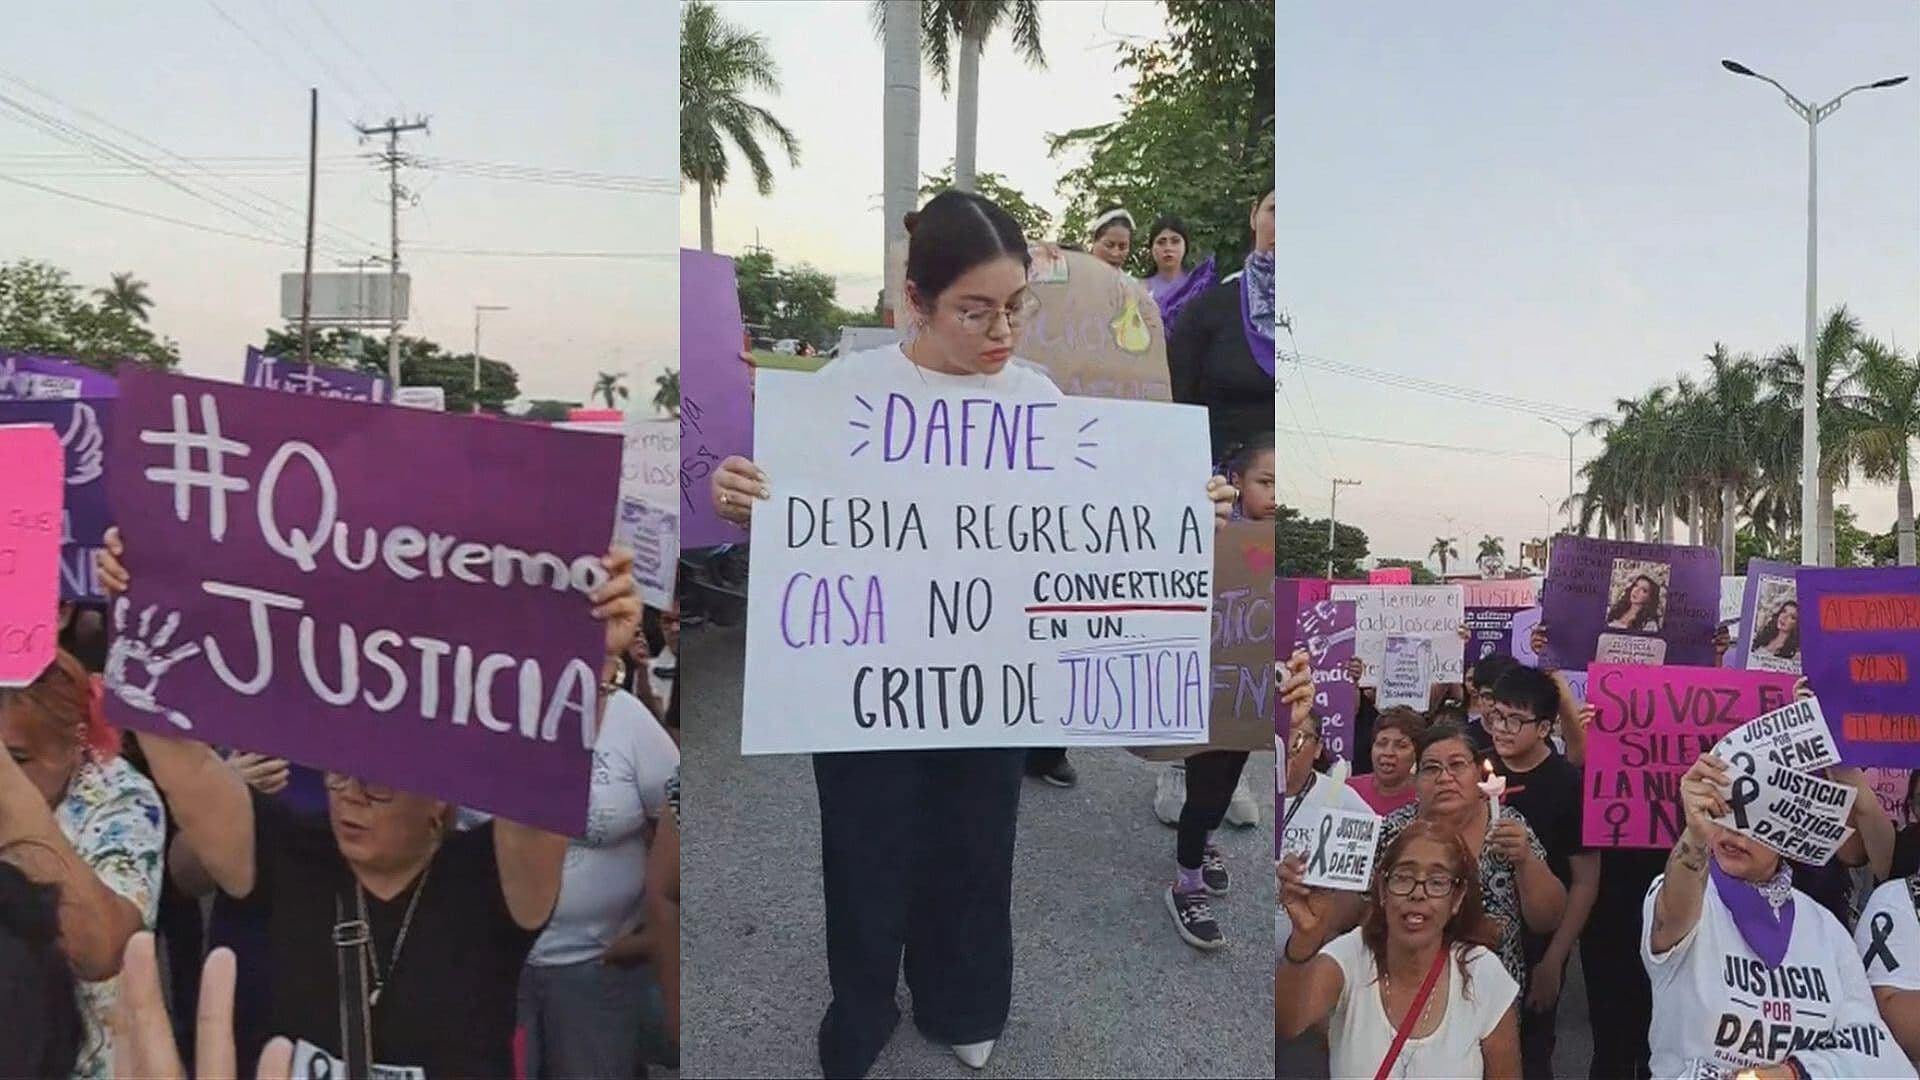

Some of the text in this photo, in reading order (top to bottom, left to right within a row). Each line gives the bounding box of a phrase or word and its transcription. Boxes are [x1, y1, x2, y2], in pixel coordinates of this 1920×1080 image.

[883, 393, 1057, 471] DAFNE
[787, 496, 1203, 553] DEBIA REGRESAR A
[781, 569, 1209, 649] CASA NO CONVERTIRSE
[1029, 618, 1068, 640] EN
[202, 580, 598, 750] JUSTICIA
[853, 650, 1204, 730] GRITO DE JUSTICIA
[1664, 683, 1746, 727] VOZ
[1743, 701, 1815, 744] JUSTICIA
[1773, 732, 1792, 747] POR
[1618, 732, 1717, 768] SILEN
[1592, 771, 1633, 800] LA
[1767, 767, 1848, 808] JUSTICIA
[1753, 820, 1832, 861] DAFNE
[1769, 798, 1846, 842] JUSTICIA
[1328, 852, 1369, 876] DAFNE
[1723, 954, 1832, 1004] JUSTICIA
[1763, 1001, 1793, 1023] POR
